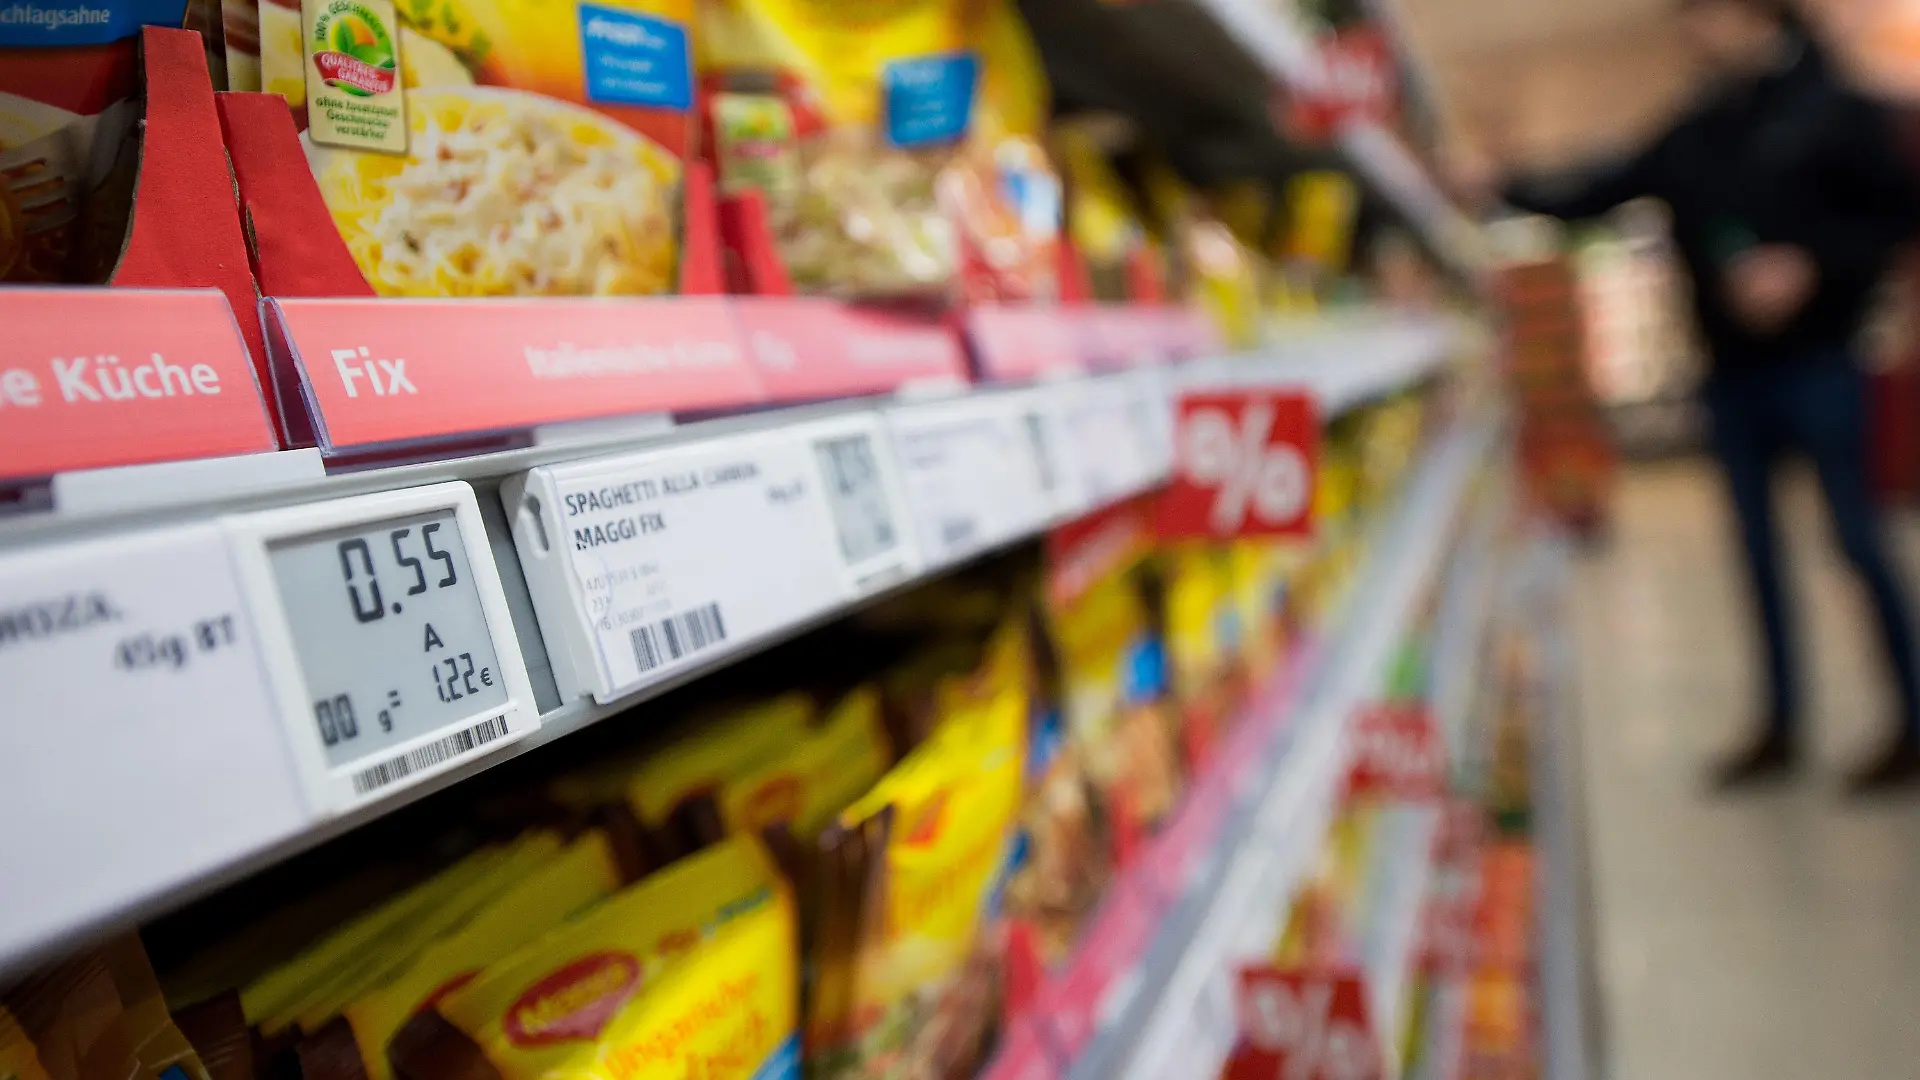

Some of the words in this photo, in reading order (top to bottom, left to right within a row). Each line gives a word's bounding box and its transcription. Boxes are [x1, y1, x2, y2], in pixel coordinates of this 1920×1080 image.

[51, 352, 221, 403] Küche
[331, 346, 418, 398] Fix
[565, 480, 658, 516] SPAGHETTI
[661, 471, 699, 494] ALLA
[574, 518, 636, 551] MAGGI
[640, 512, 667, 535] FIX
[337, 523, 457, 623] 0.55
[424, 622, 444, 652] A
